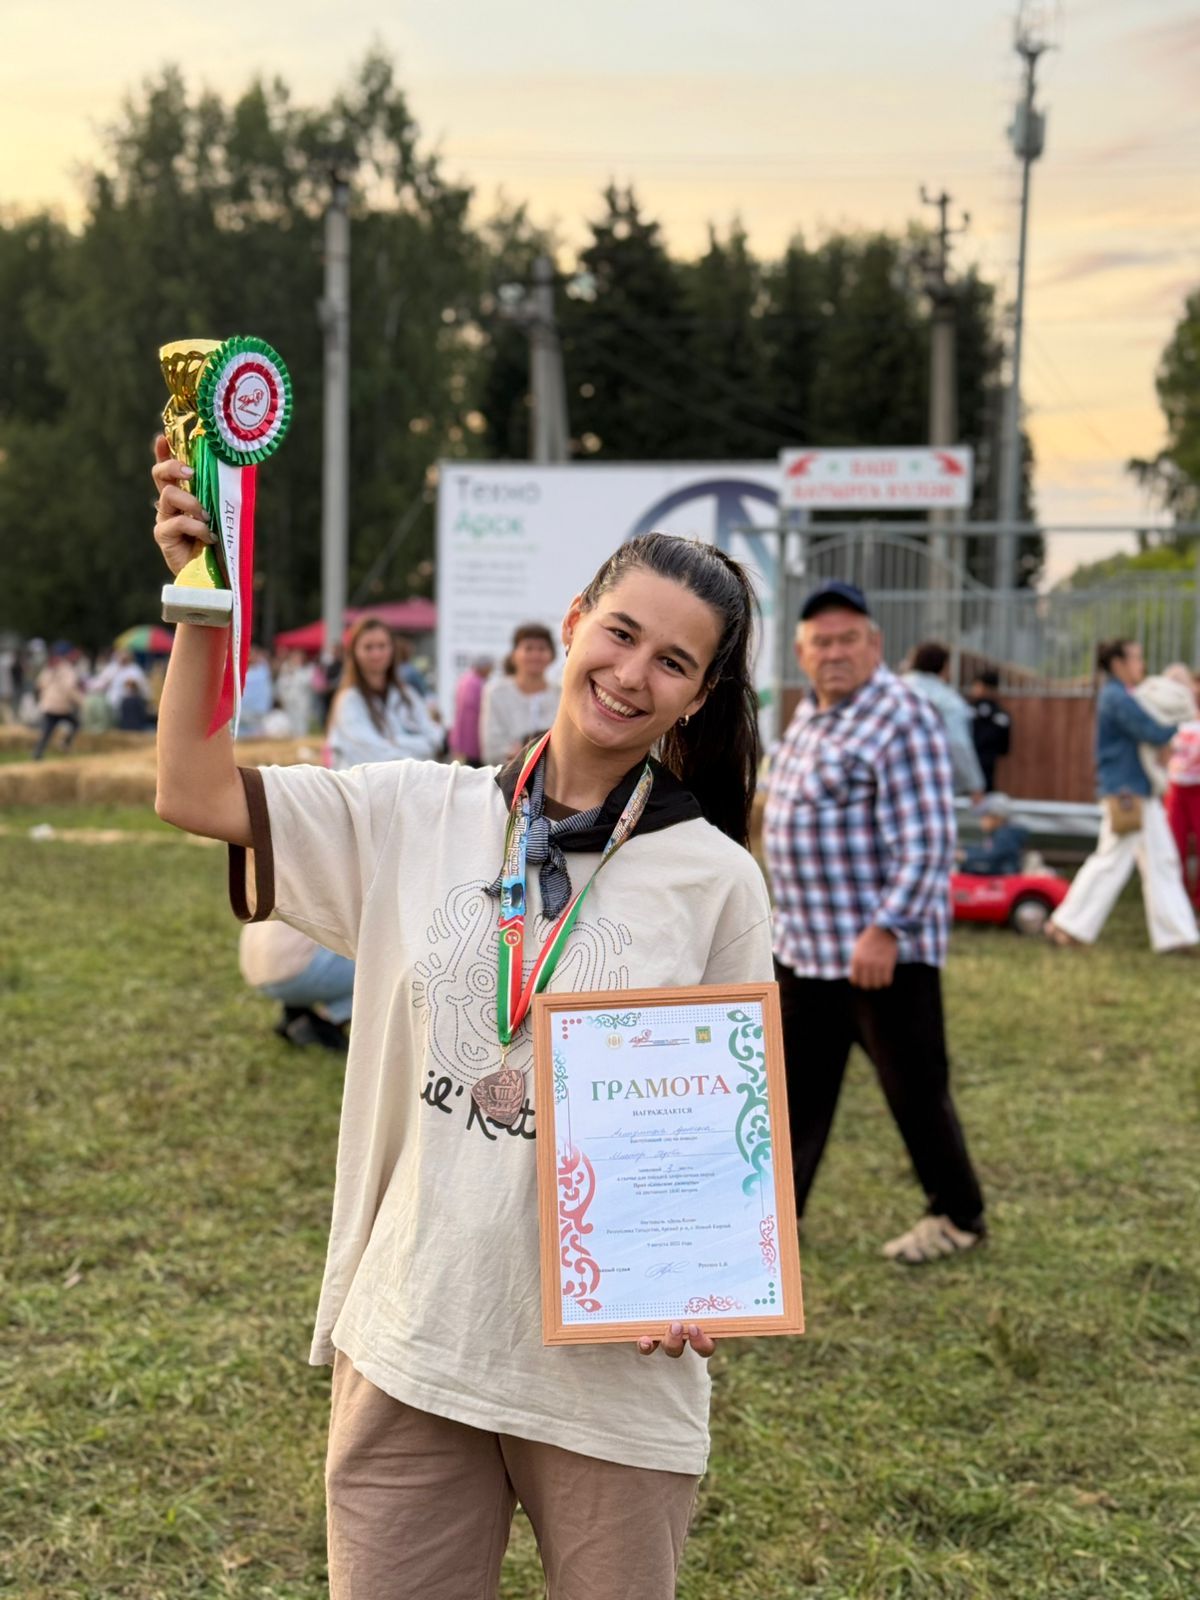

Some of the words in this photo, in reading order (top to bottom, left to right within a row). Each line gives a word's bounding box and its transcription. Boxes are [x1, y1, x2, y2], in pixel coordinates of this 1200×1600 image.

[455, 475, 541, 504] Техно
[224, 499, 235, 550] ДЕНЬ
[591, 1074, 732, 1101] ГРАМОТА
[632, 1106, 693, 1117] НАГРАЖДАЕТСЯ
